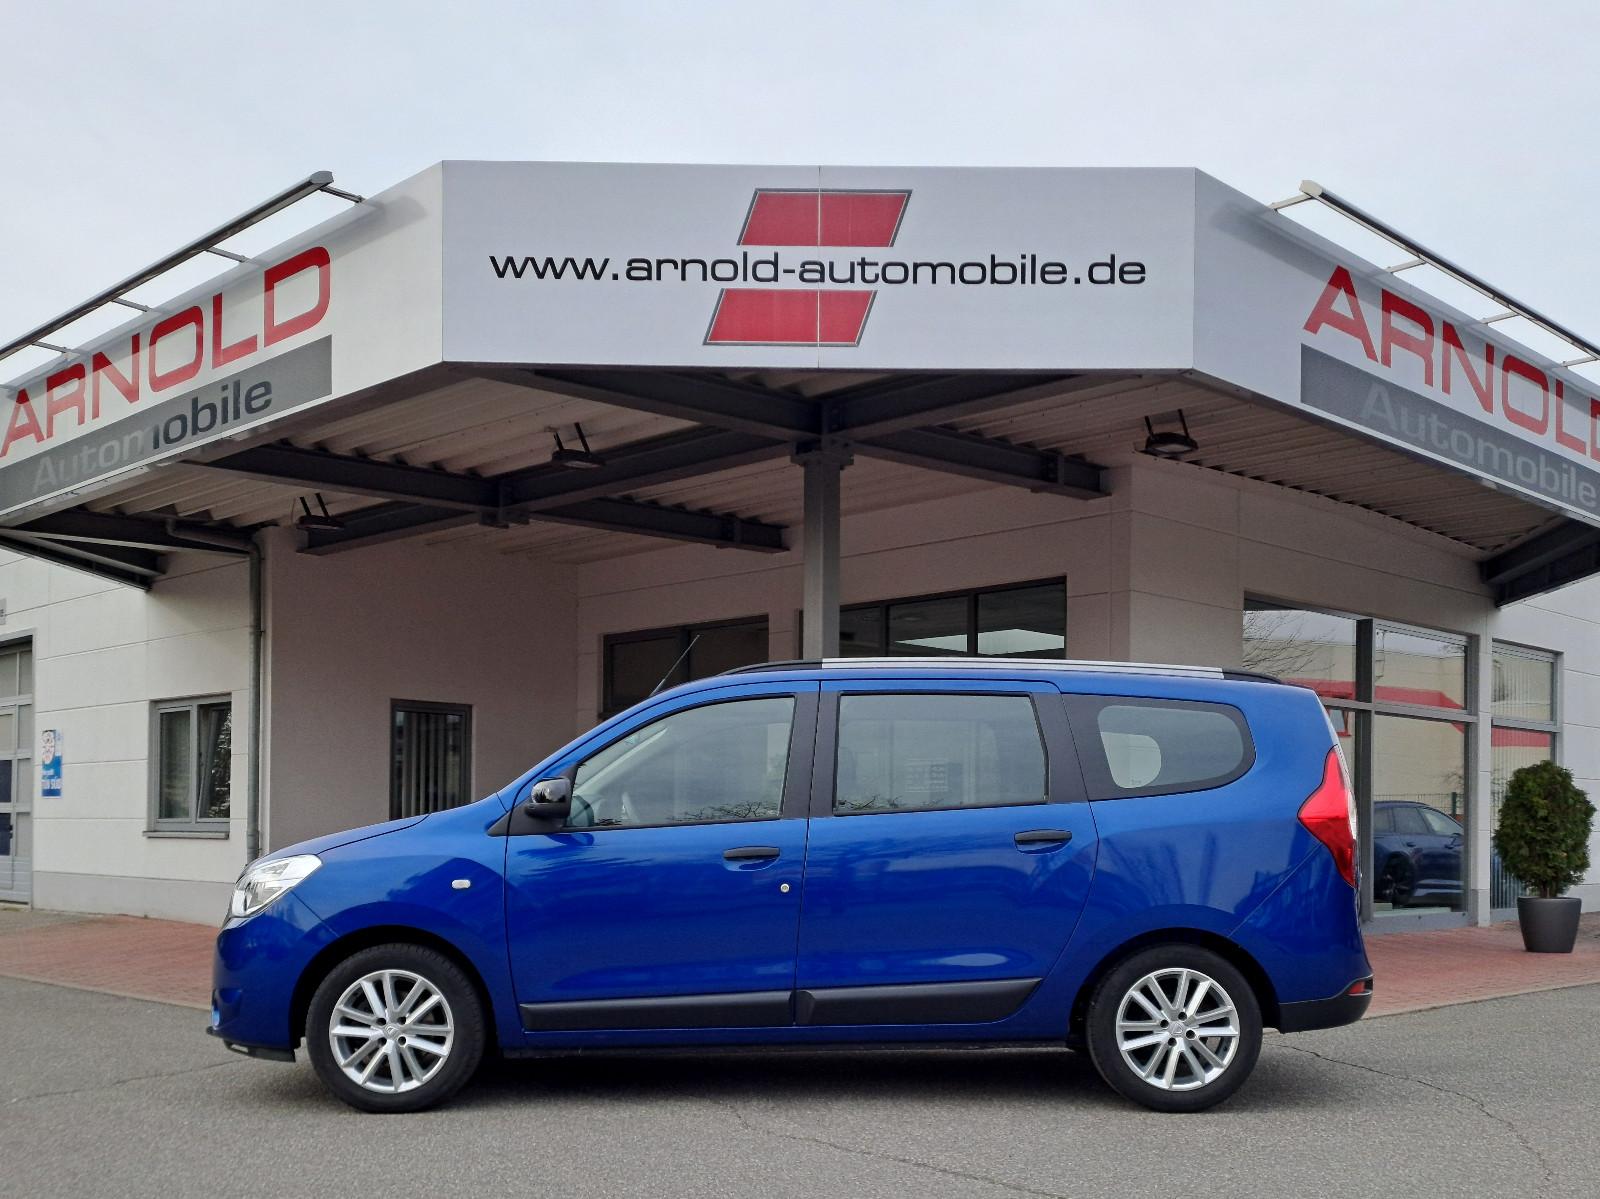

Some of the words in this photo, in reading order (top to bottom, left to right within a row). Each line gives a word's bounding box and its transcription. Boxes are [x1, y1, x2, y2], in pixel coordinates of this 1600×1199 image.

[489, 251, 1147, 286] www.arnold-automobile.de
[0, 246, 331, 458] ARNOLD
[1303, 265, 1600, 463] ARNOL
[32, 379, 273, 493] Automobile
[1359, 382, 1598, 507] Automobile
